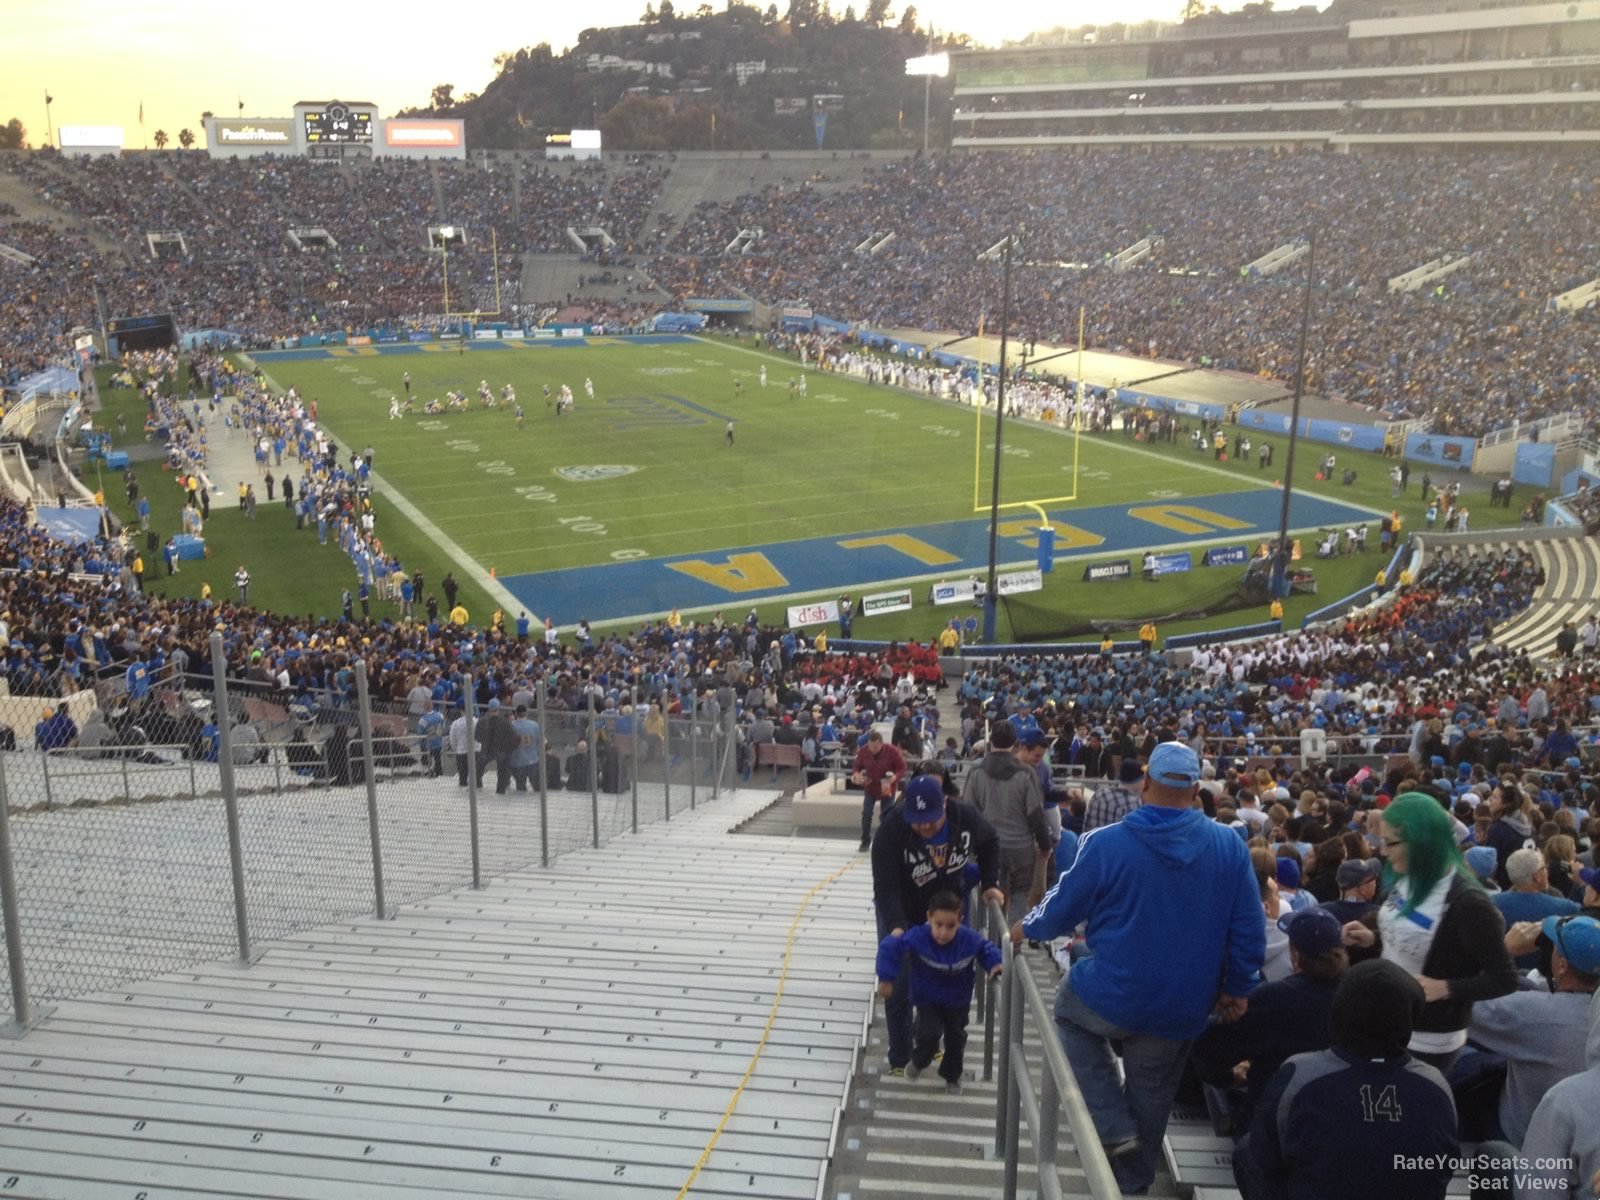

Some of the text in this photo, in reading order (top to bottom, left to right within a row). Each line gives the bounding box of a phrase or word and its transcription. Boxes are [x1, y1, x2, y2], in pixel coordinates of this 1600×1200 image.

[515, 485, 558, 503] 20
[559, 516, 608, 536] 10
[1090, 567, 1114, 577] MUSCLE
[798, 607, 827, 623] dish
[548, 1102, 559, 1112] 3
[1360, 1084, 1402, 1122] 14
[659, 1110, 669, 1121] 2
[250, 1132, 263, 1144] 5
[363, 1145, 375, 1156] 4
[489, 1155, 502, 1167] 3
[613, 1164, 626, 1177] 2
[2, 1175, 20, 1190] 6
[748, 1175, 756, 1187] 1
